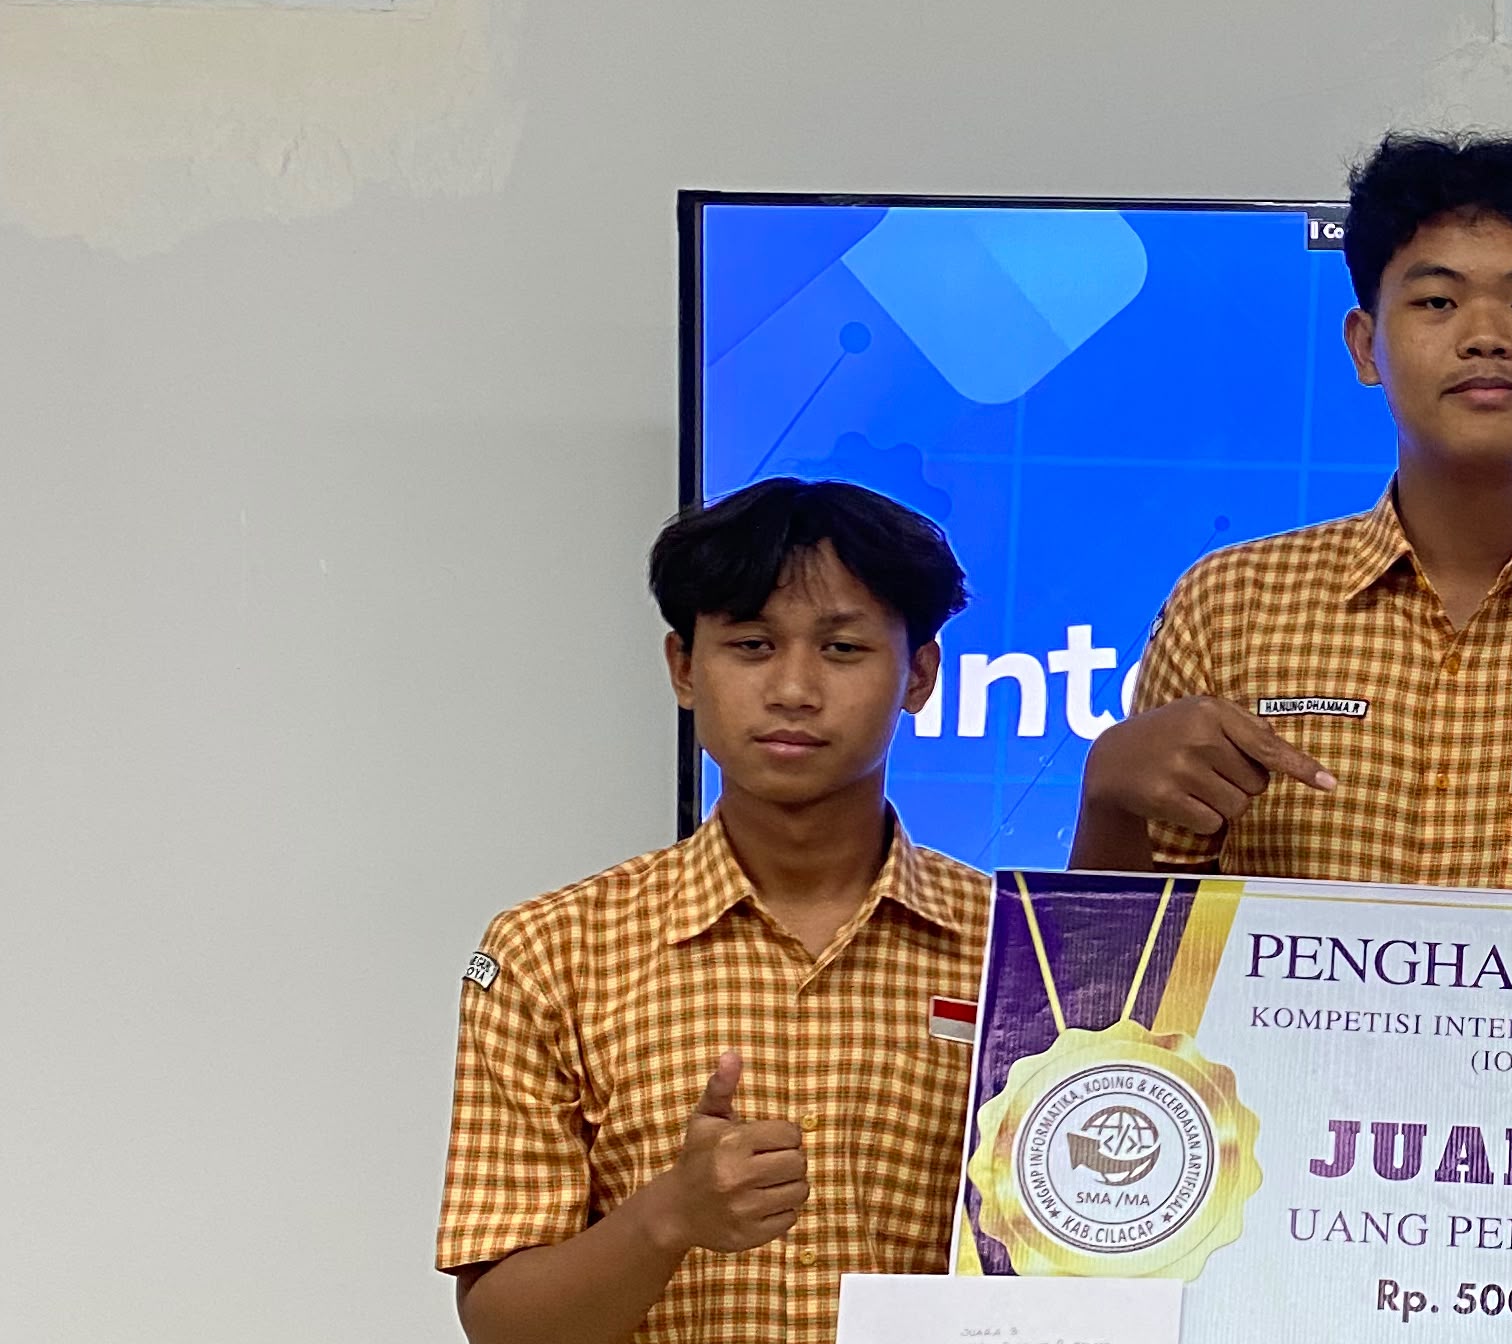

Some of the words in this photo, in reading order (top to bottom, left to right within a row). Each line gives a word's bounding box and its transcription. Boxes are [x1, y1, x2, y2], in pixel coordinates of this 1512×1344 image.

[1250, 1005, 1422, 1036] KOMPETISI
[1084, 1076, 1134, 1095] KODING
[1137, 1078, 1147, 1092] &
[1149, 1084, 1201, 1150] KECERDASAN
[1030, 1170, 1056, 1210] MGMP
[1076, 1191, 1111, 1205] SMA
[1166, 1152, 1202, 1215] ARTIFISIAL
[1288, 1207, 1430, 1248] UANG
[1376, 1278, 1439, 1324] Rp.
